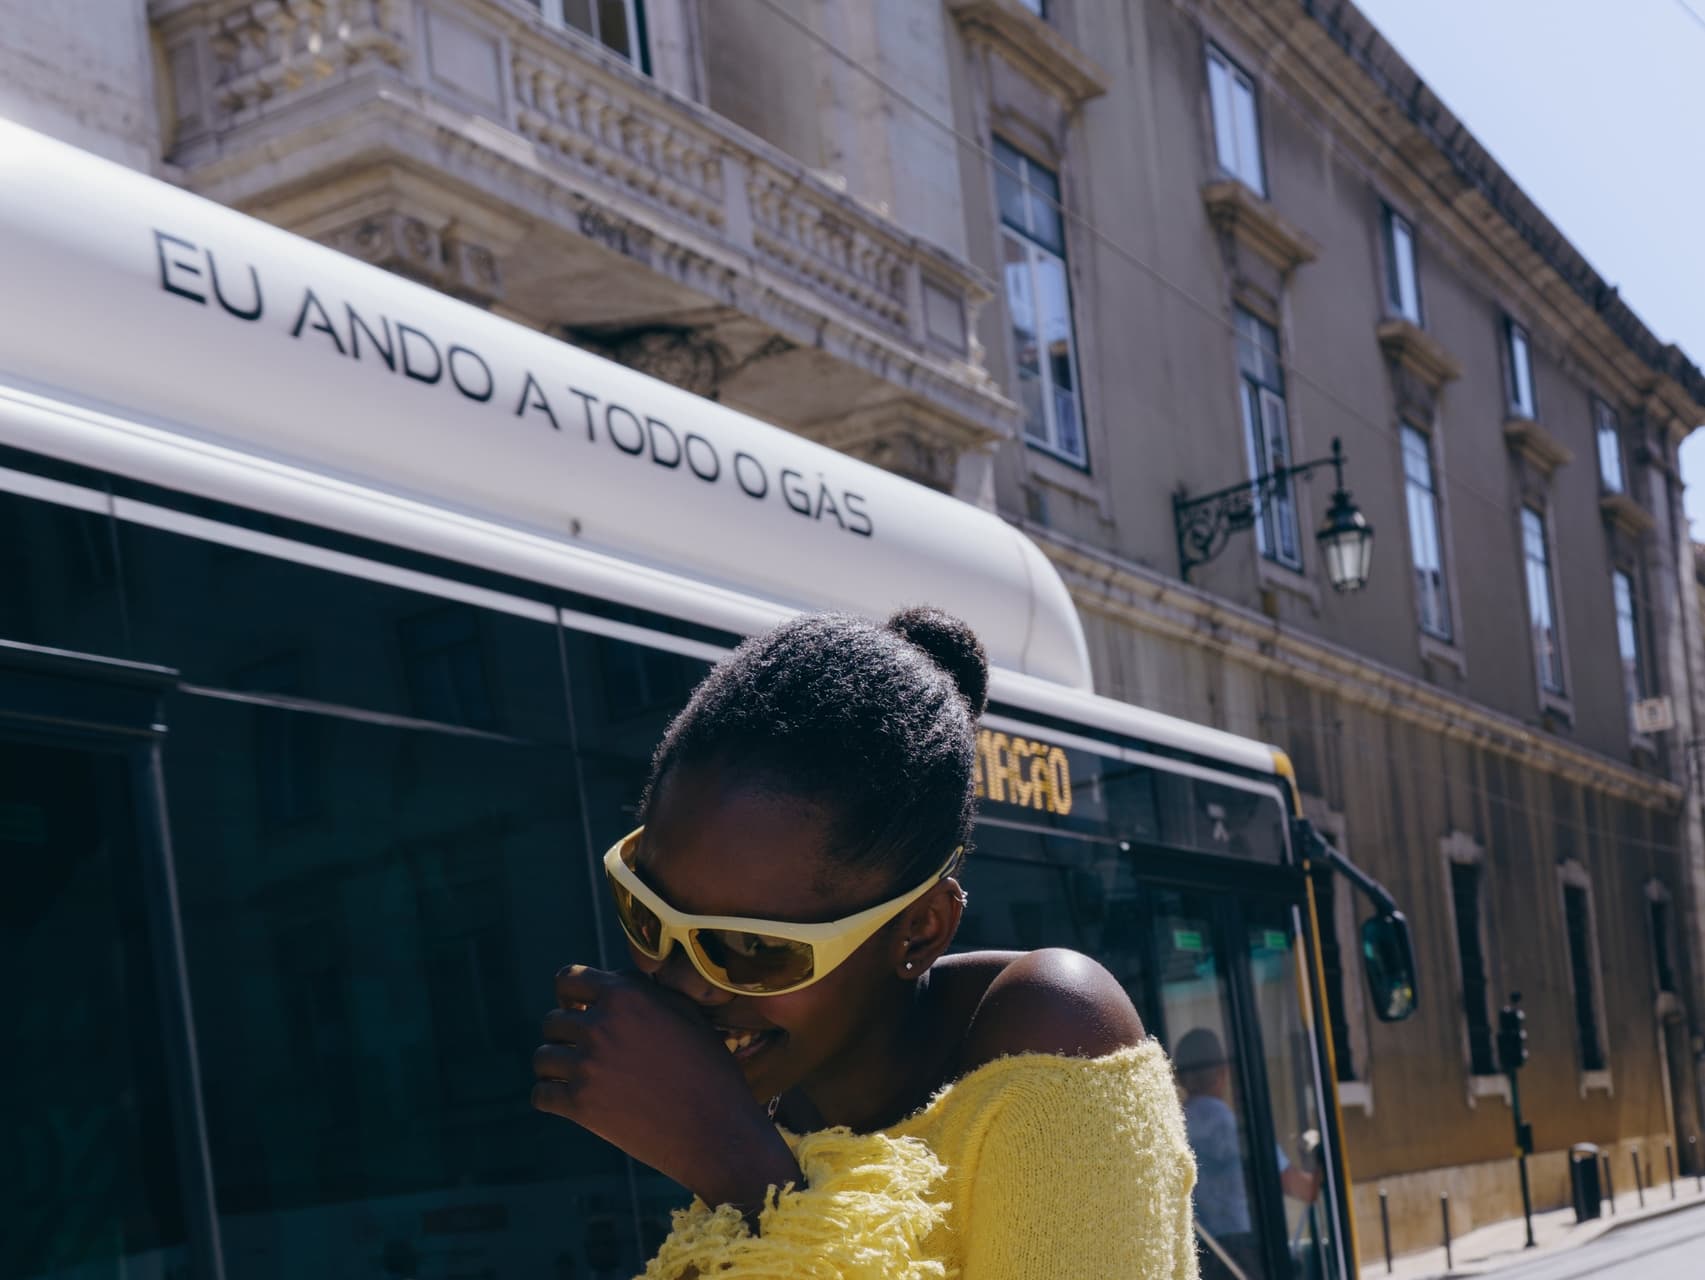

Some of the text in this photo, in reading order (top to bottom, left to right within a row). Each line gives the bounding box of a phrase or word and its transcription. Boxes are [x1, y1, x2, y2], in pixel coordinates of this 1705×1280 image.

[154, 230, 263, 321] EU
[290, 287, 493, 403] ANDO
[515, 372, 560, 430] A
[568, 387, 720, 483] TODO
[734, 452, 768, 499] O
